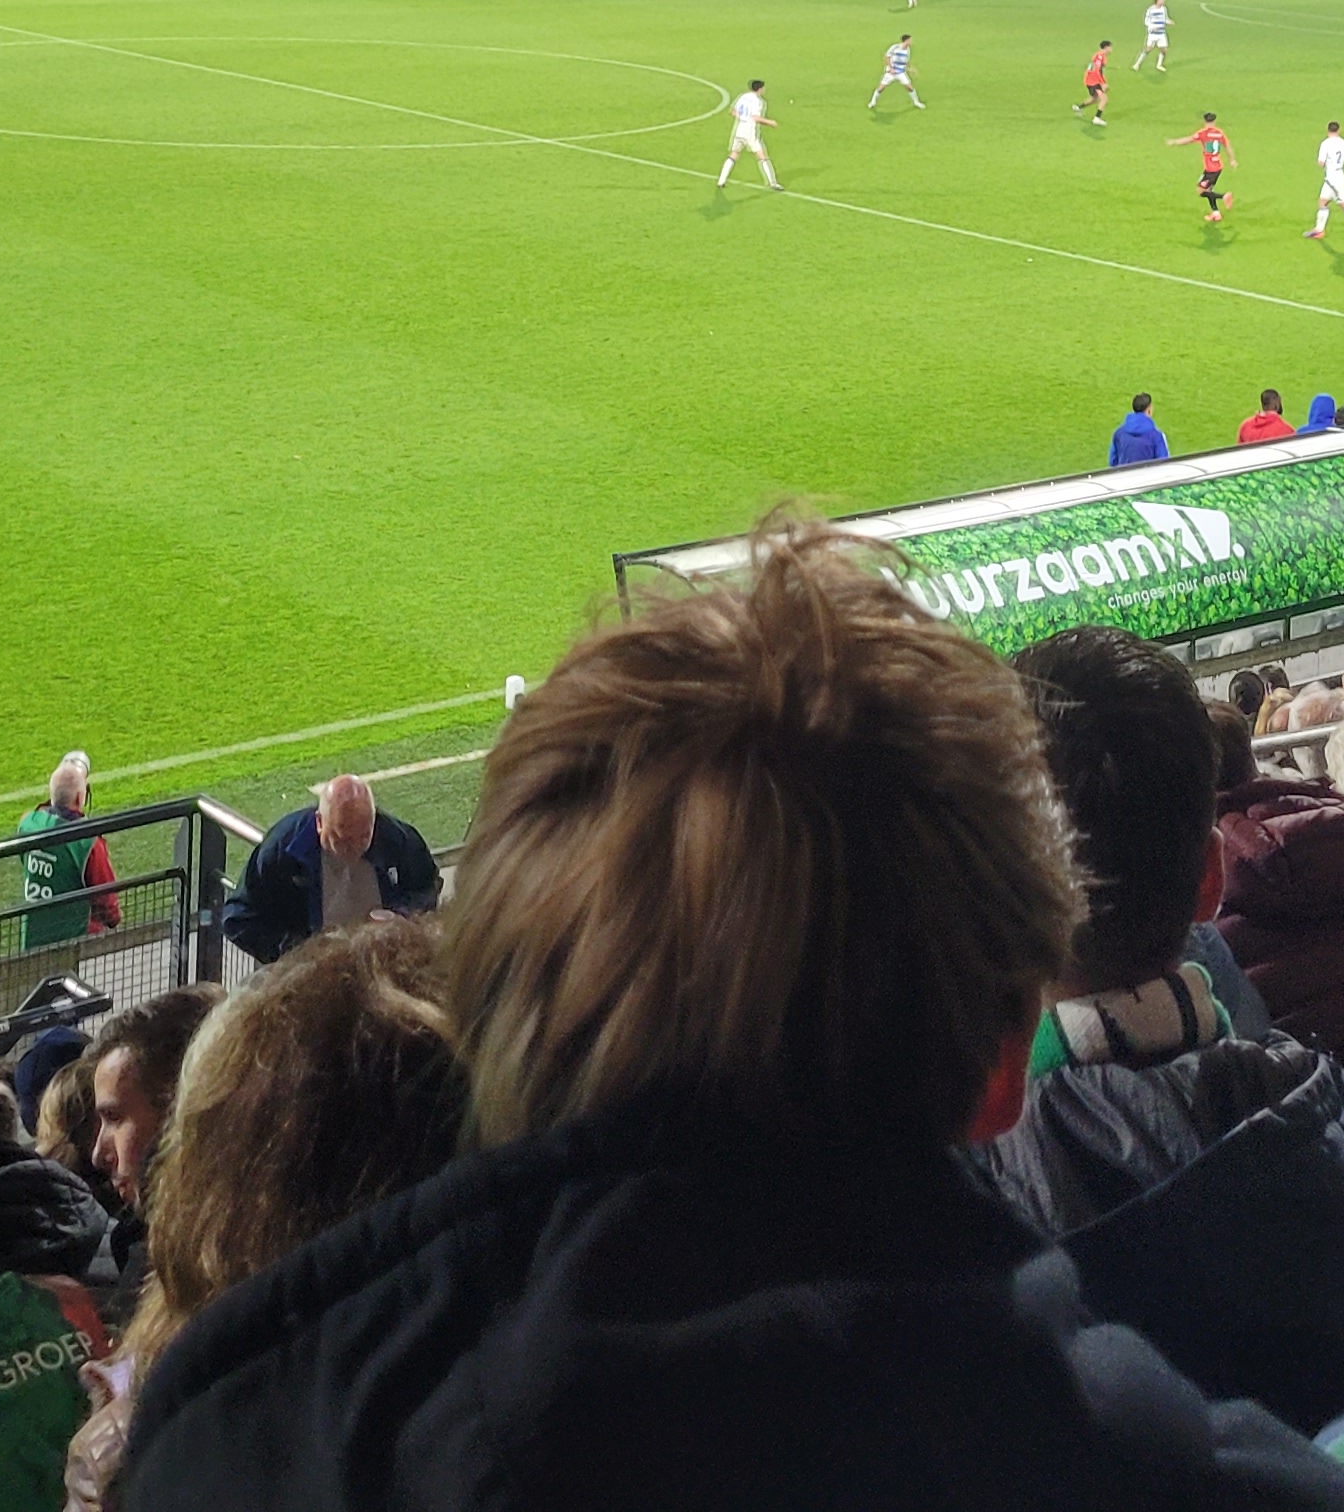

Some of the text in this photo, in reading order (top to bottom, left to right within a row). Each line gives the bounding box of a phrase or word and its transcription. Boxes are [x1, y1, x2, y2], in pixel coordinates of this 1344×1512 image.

[1107, 568, 1248, 610] changes your energy
[28, 853, 54, 879] OTO
